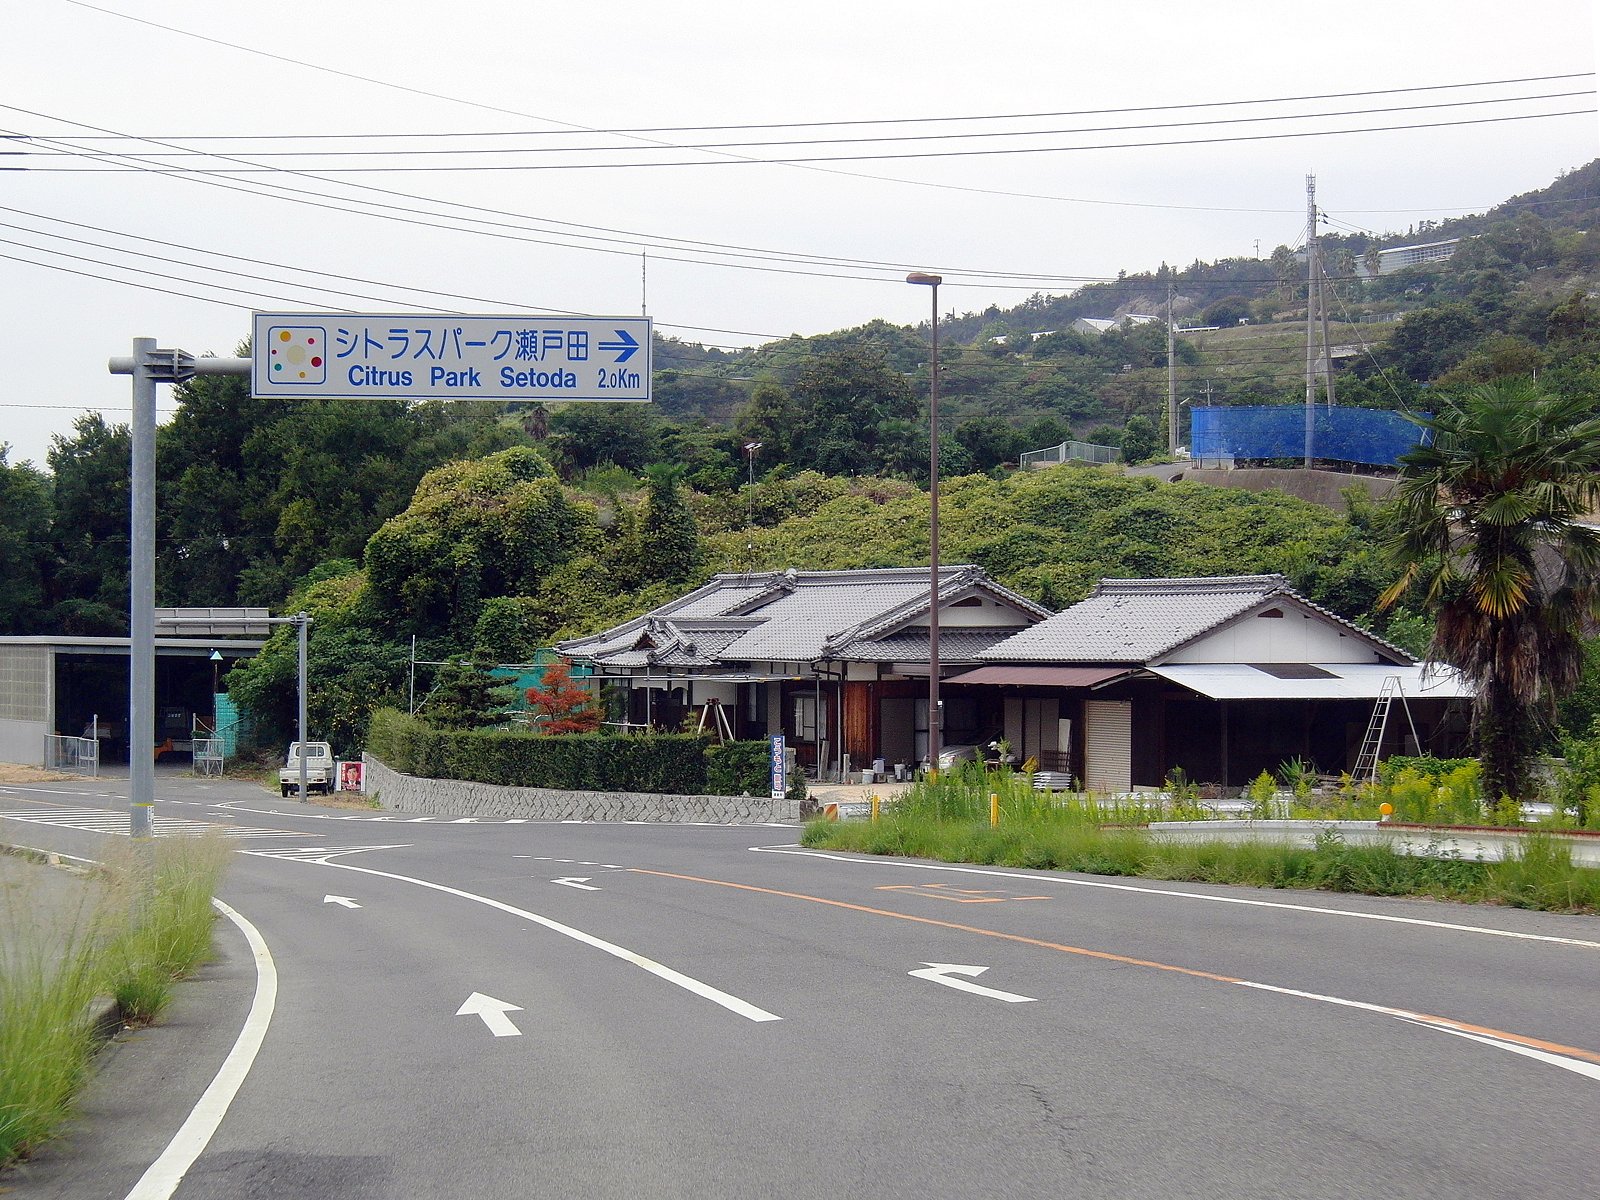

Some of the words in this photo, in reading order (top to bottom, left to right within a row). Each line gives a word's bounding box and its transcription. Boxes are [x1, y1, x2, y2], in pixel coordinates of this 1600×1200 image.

[335, 328, 589, 361] シトラスパーク瀬戸田
[348, 365, 413, 387] Citrus
[430, 366, 482, 388] Park
[499, 366, 577, 388] Setoda
